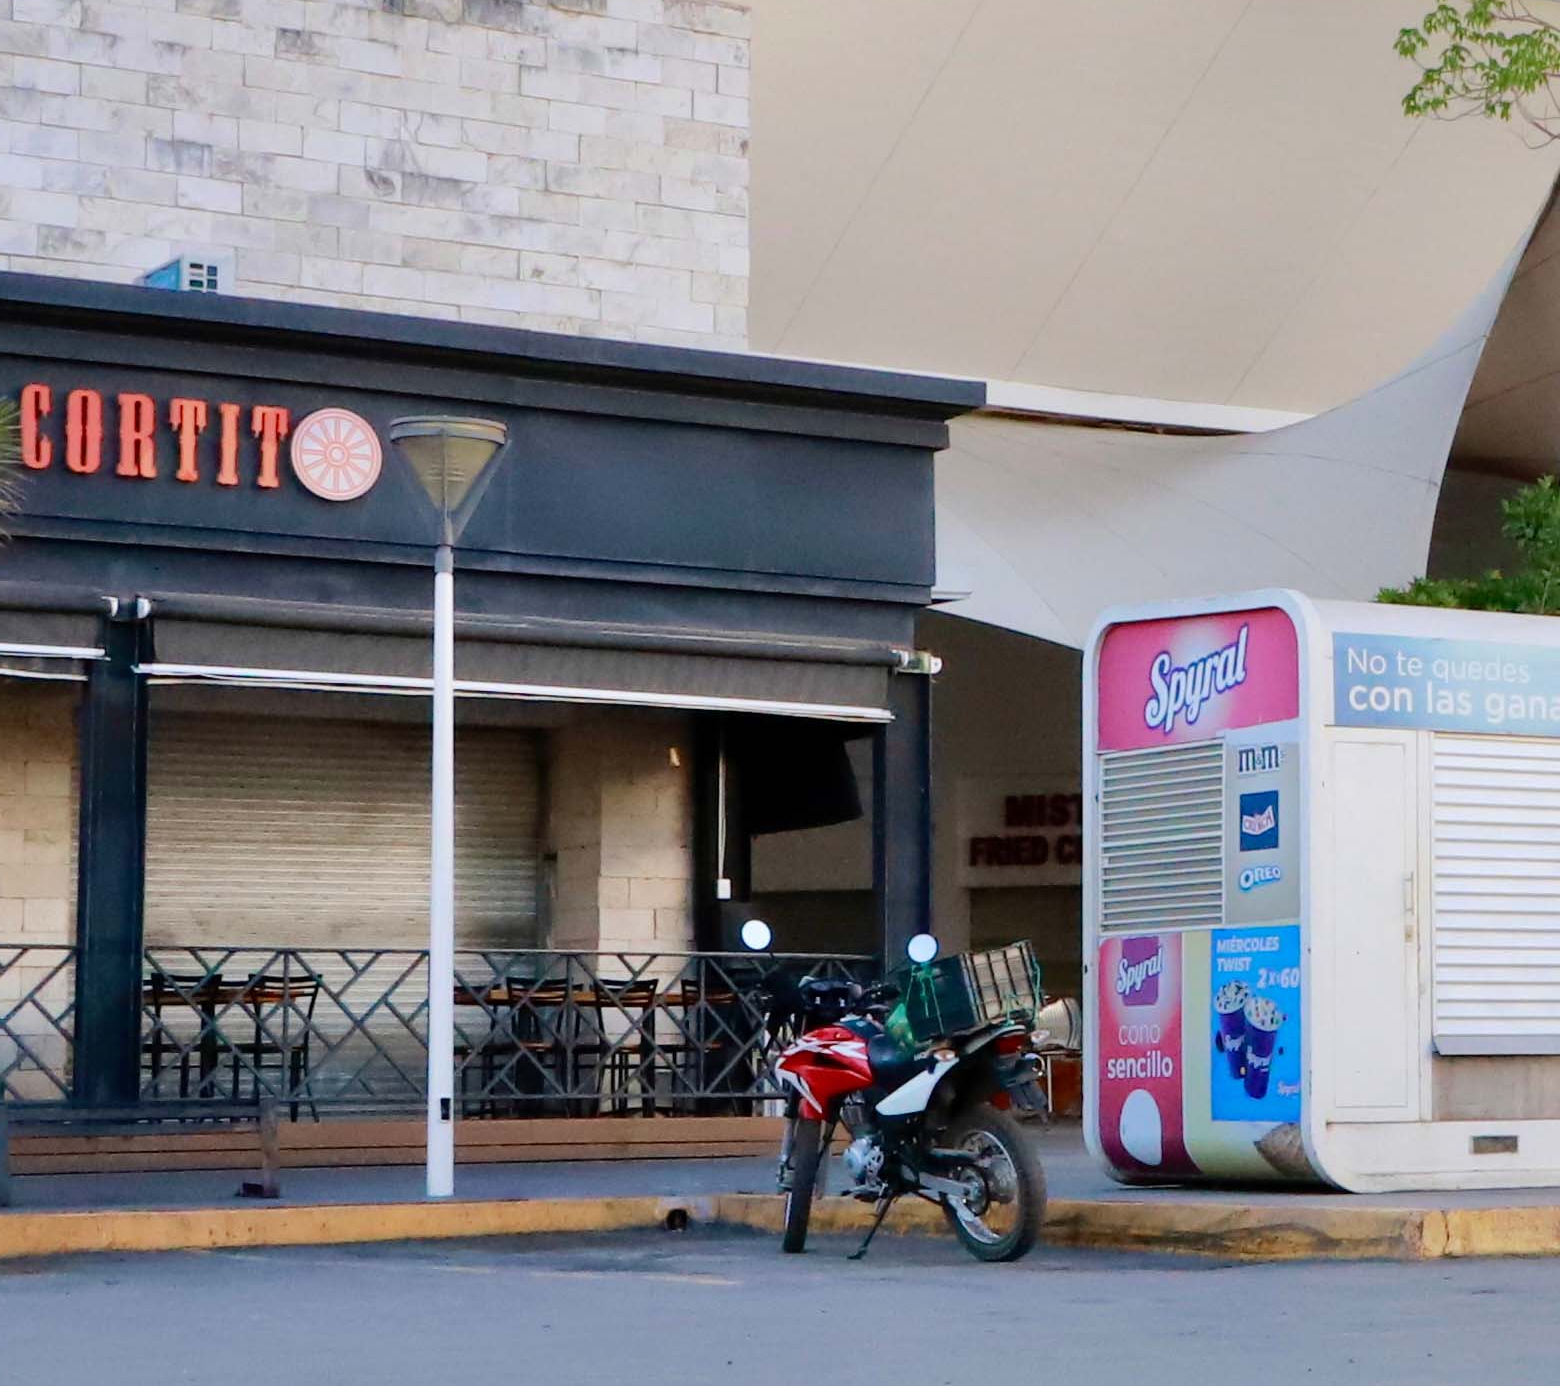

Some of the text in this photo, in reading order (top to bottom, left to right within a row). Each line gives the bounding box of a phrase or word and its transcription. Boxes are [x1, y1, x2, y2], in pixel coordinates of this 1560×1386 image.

[1144, 623, 1248, 735] Spyral
[1347, 647, 1530, 684] No te quedes
[1348, 684, 1413, 712] con
[1427, 681, 1472, 715] las
[1240, 866, 1281, 891] OREO
[1217, 935, 1280, 954] MIÉRCOLES
[1117, 947, 1163, 995] Spyral
[1217, 957, 1252, 972] TWIST
[1118, 1024, 1161, 1046] cono
[1107, 1050, 1174, 1079] sencillo
